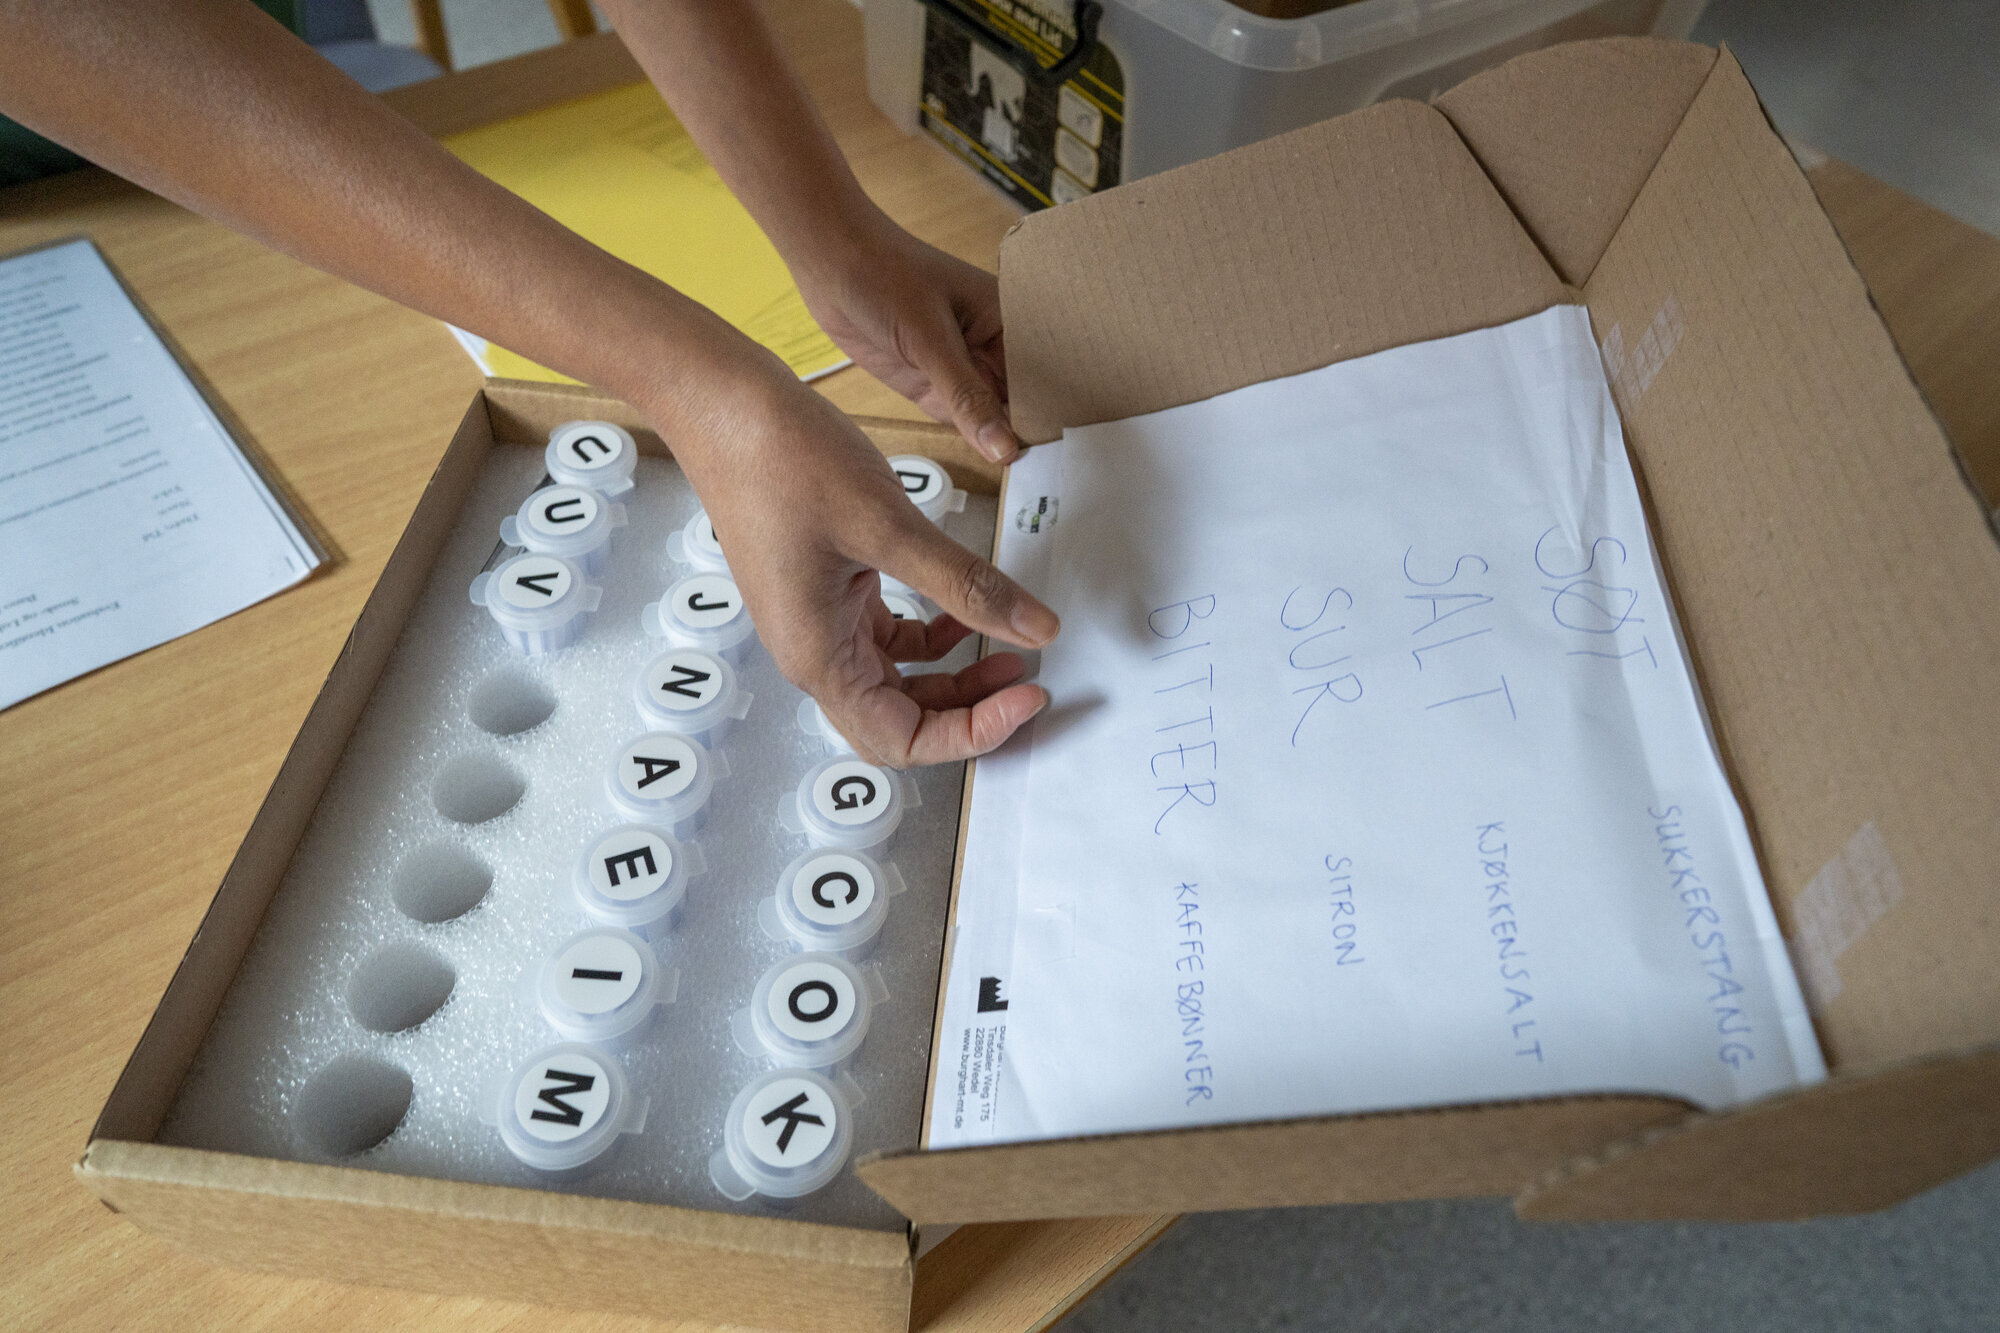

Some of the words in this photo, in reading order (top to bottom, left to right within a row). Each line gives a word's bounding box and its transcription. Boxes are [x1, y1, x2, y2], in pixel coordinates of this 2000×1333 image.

[544, 498, 585, 524] U
[515, 571, 560, 597] V
[687, 592, 729, 611] J
[1534, 524, 1658, 668] SØT
[1403, 544, 1516, 720] SALT
[661, 664, 711, 699] N
[1280, 586, 1363, 747] SUR
[1147, 593, 1217, 836] BITTER
[632, 756, 681, 790] A
[830, 775, 876, 811] G
[604, 845, 658, 887] E
[811, 871, 859, 909] C
[1324, 853, 1365, 967] SITRON
[1476, 821, 1543, 1063] KJØKKENSALT
[1647, 804, 1755, 1070] SUKKERSTANG
[571, 968, 623, 982] I
[788, 980, 839, 1023] O
[974, 1027, 985, 1059] 22880
[985, 1026, 998, 1072] Tinsdaler
[970, 1060, 982, 1094] Wedel
[980, 1074, 993, 1099] Weg
[530, 1069, 596, 1127] M
[980, 1102, 990, 1122] 175
[761, 1092, 826, 1155] K
